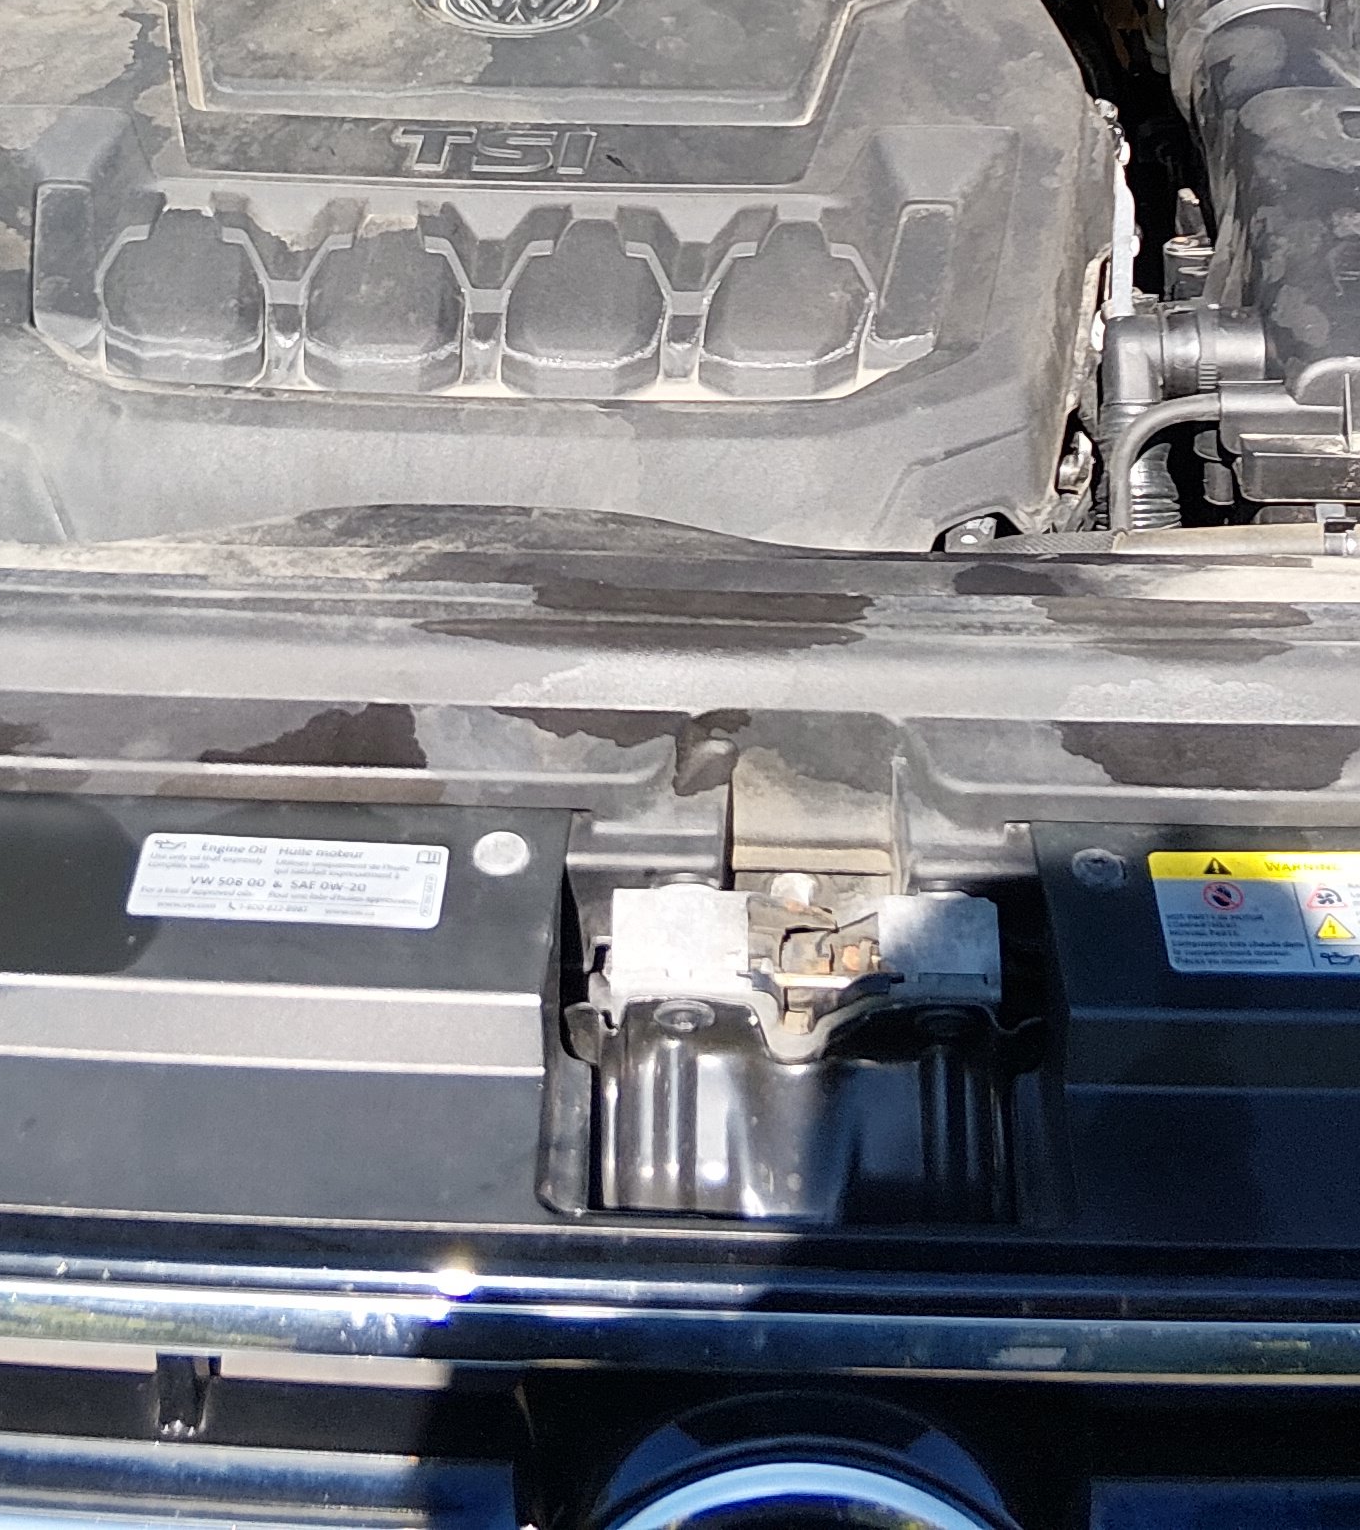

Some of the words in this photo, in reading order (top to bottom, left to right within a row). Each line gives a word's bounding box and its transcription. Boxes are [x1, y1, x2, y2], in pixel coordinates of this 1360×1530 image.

[396, 126, 598, 177] TSI
[202, 842, 245, 854] Engine
[248, 844, 267, 854] Oil
[279, 847, 312, 856] Huile
[315, 849, 364, 859] moteur
[190, 876, 215, 885] VW
[246, 878, 266, 887] 00
[272, 880, 283, 888] &
